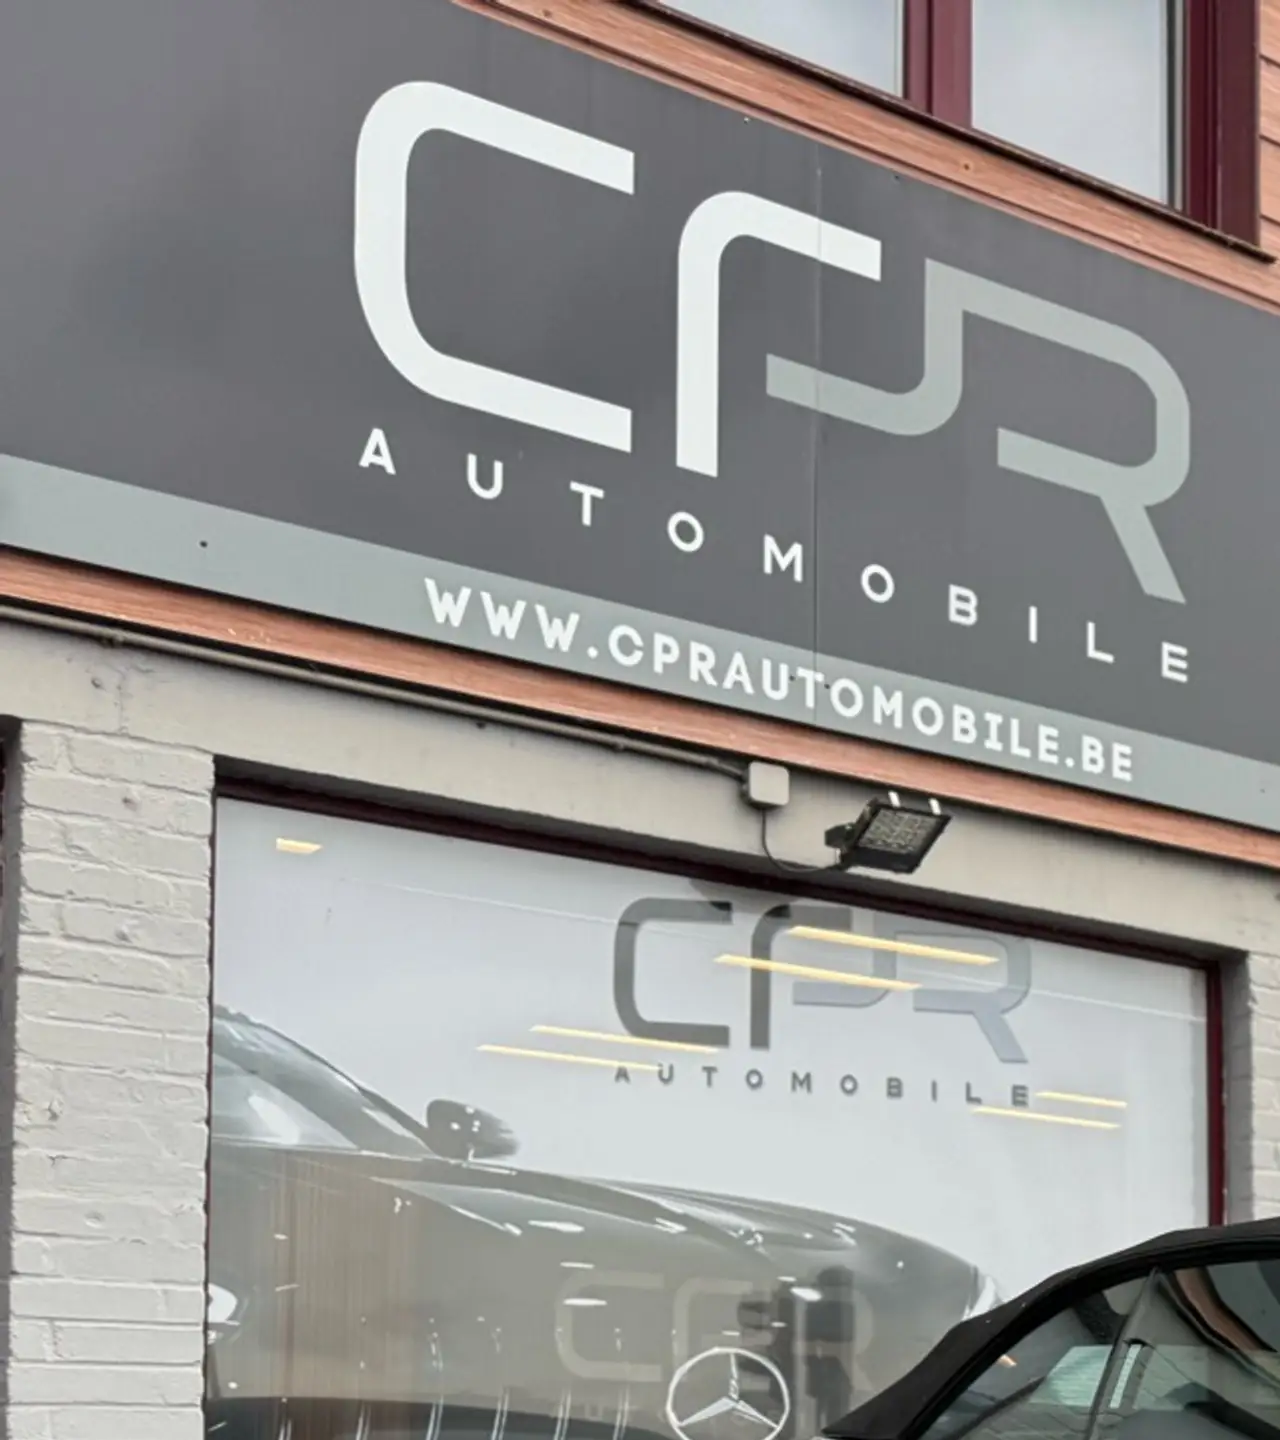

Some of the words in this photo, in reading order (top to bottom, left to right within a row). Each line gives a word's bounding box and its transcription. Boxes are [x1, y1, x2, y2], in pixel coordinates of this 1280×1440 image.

[354, 81, 1190, 603] CPR
[359, 428, 1188, 683] AUTOMOBILE
[424, 577, 1133, 782] WWW.CPRAUTOMOBILE.BE
[613, 896, 1032, 1064] CPR
[614, 1063, 1030, 1107] AUTOMOBILE
